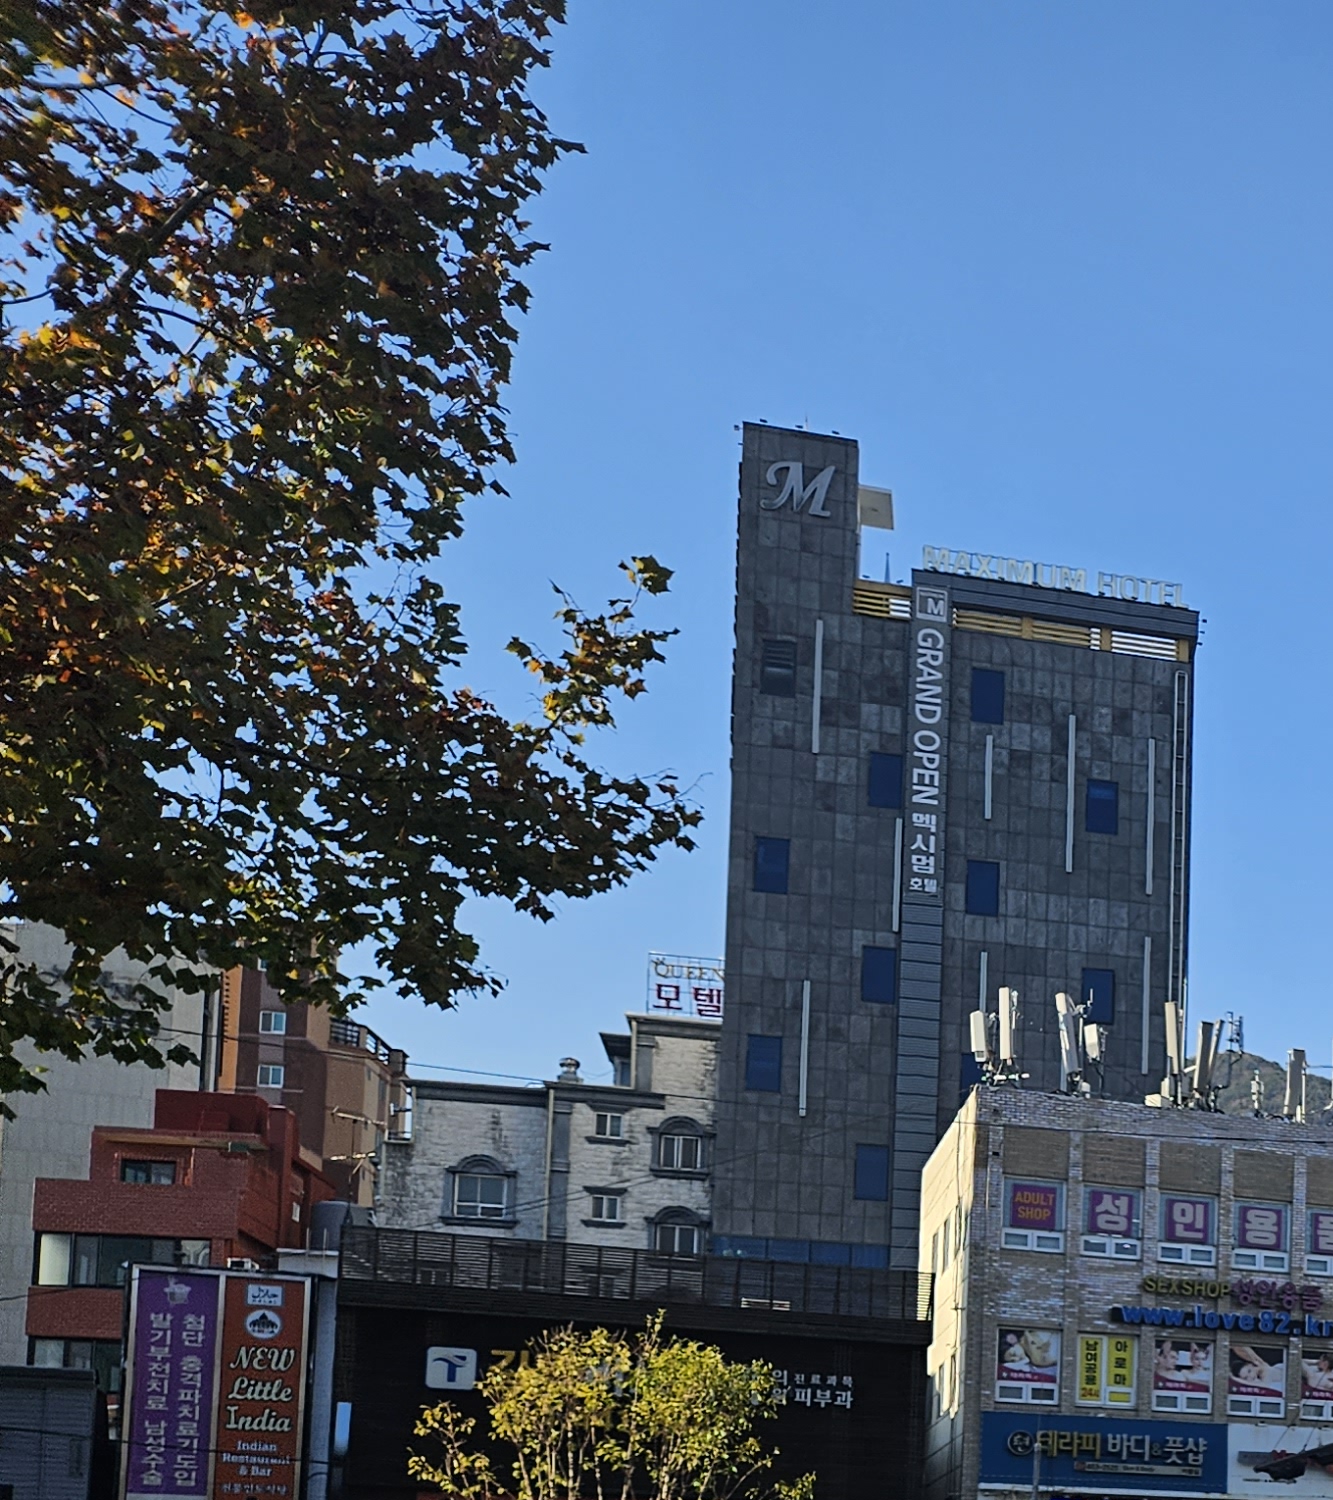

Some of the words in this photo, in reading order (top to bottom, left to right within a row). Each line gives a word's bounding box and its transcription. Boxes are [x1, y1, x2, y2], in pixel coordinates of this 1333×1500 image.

[760, 461, 835, 517] M
[922, 545, 1087, 594] MAXIMUM
[1097, 571, 1189, 610] HOTEL
[914, 628, 945, 725] GRAND
[911, 729, 942, 805] OPEN
[908, 878, 938, 894] 호텔
[652, 983, 723, 1017] 모텔
[1014, 1191, 1055, 1207] ADULT
[1017, 1205, 1052, 1221] SHOP
[1143, 1277, 1180, 1294] SEX
[1181, 1279, 1231, 1299] SHOP
[183, 1313, 205, 1348] 첨단
[144, 1313, 174, 1411] 발기부전치료
[230, 1347, 295, 1370] NEW
[1114, 1341, 1128, 1386] 아로마
[228, 1377, 293, 1402] Little
[794, 1372, 854, 1388] 진료과목
[793, 1388, 854, 1409] 피부과
[225, 1405, 292, 1432] India
[140, 1420, 168, 1486] 남성수술
[236, 1439, 278, 1451] Indian
[1037, 1430, 1101, 1460] 테라피
[251, 1465, 273, 1477] Bar
